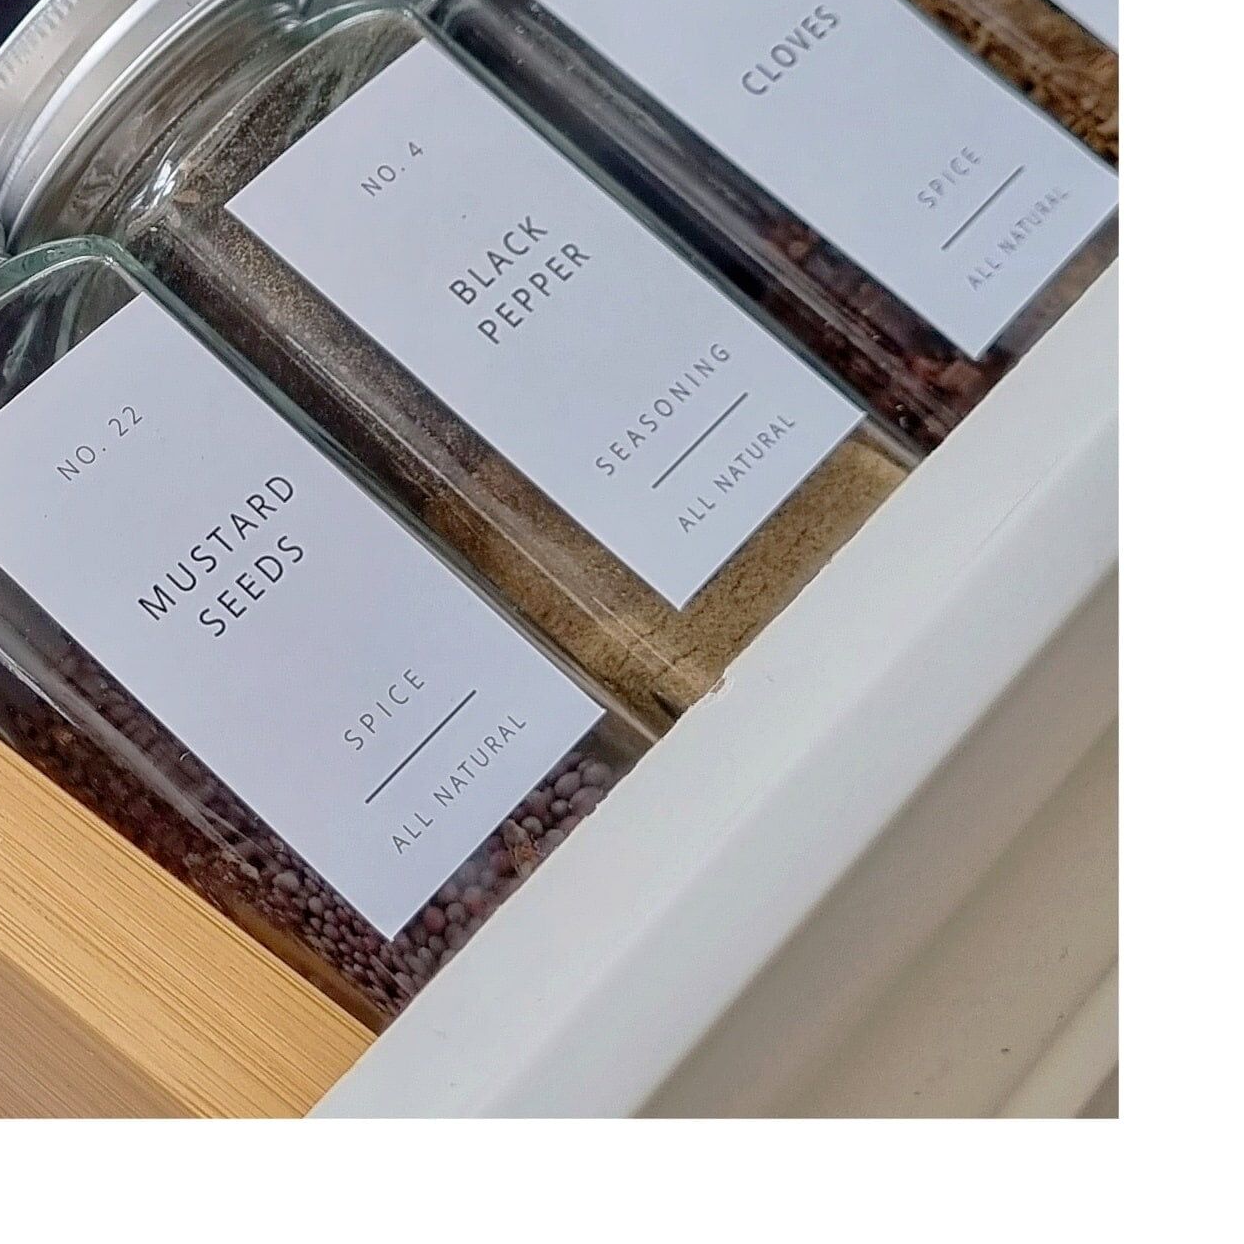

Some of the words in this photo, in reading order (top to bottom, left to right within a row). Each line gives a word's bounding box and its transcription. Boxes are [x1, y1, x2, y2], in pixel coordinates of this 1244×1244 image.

[740, 4, 840, 96] CLOVES
[358, 163, 406, 197] NO.
[406, 140, 424, 158] 4
[915, 145, 982, 210] SPICE
[447, 214, 549, 306] BLACK
[965, 256, 1003, 291] ALL
[996, 188, 1070, 255] NATURAL
[475, 242, 591, 345] PEPPER
[55, 444, 107, 482] NO.
[106, 404, 143, 437] 22
[594, 342, 731, 477] SEASONING
[676, 495, 717, 534] ALL
[711, 414, 797, 494] NATURAL
[136, 475, 294, 621] MUSTARD
[197, 534, 304, 638] SEEDS
[342, 667, 426, 751] SPICE
[390, 811, 434, 855] ALL
[431, 714, 527, 808] NATURAL
